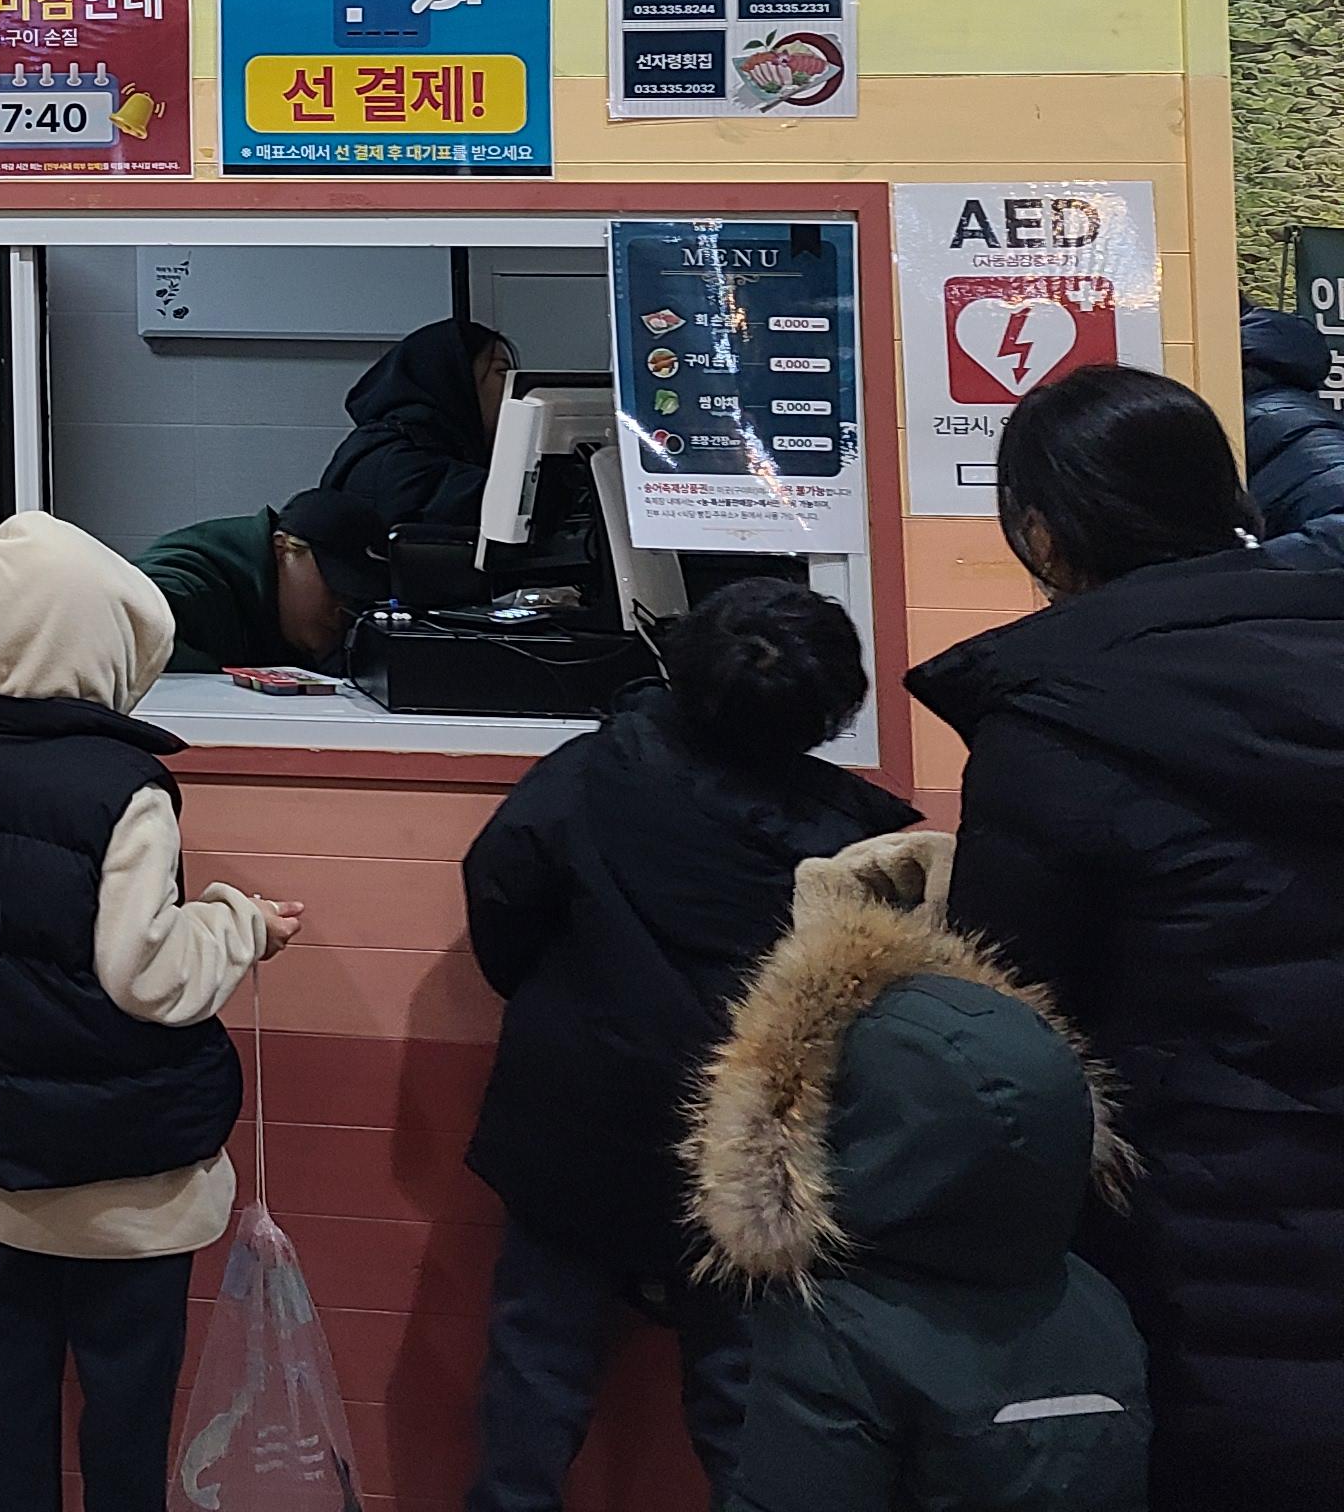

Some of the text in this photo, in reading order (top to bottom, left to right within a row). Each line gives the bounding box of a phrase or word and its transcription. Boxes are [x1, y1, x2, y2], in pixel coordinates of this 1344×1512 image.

[43, 27, 80, 48] 손질
[282, 64, 487, 124] 선 결제!
[256, 144, 331, 161] 매표소에서
[334, 144, 351, 161] 선
[353, 144, 385, 161] 결제
[387, 144, 403, 161] 후
[406, 144, 468, 162] 대기표를
[471, 144, 534, 162] 받으세요
[949, 197, 1102, 250] AED
[681, 248, 780, 268] MENU
[694, 313, 709, 327] 회
[773, 319, 810, 329] 4,000
[683, 353, 710, 368] 구이
[774, 359, 810, 370] 4,000
[775, 401, 812, 413] 5,000
[932, 415, 996, 438] 긴급시,
[777, 438, 813, 449] 2,000
